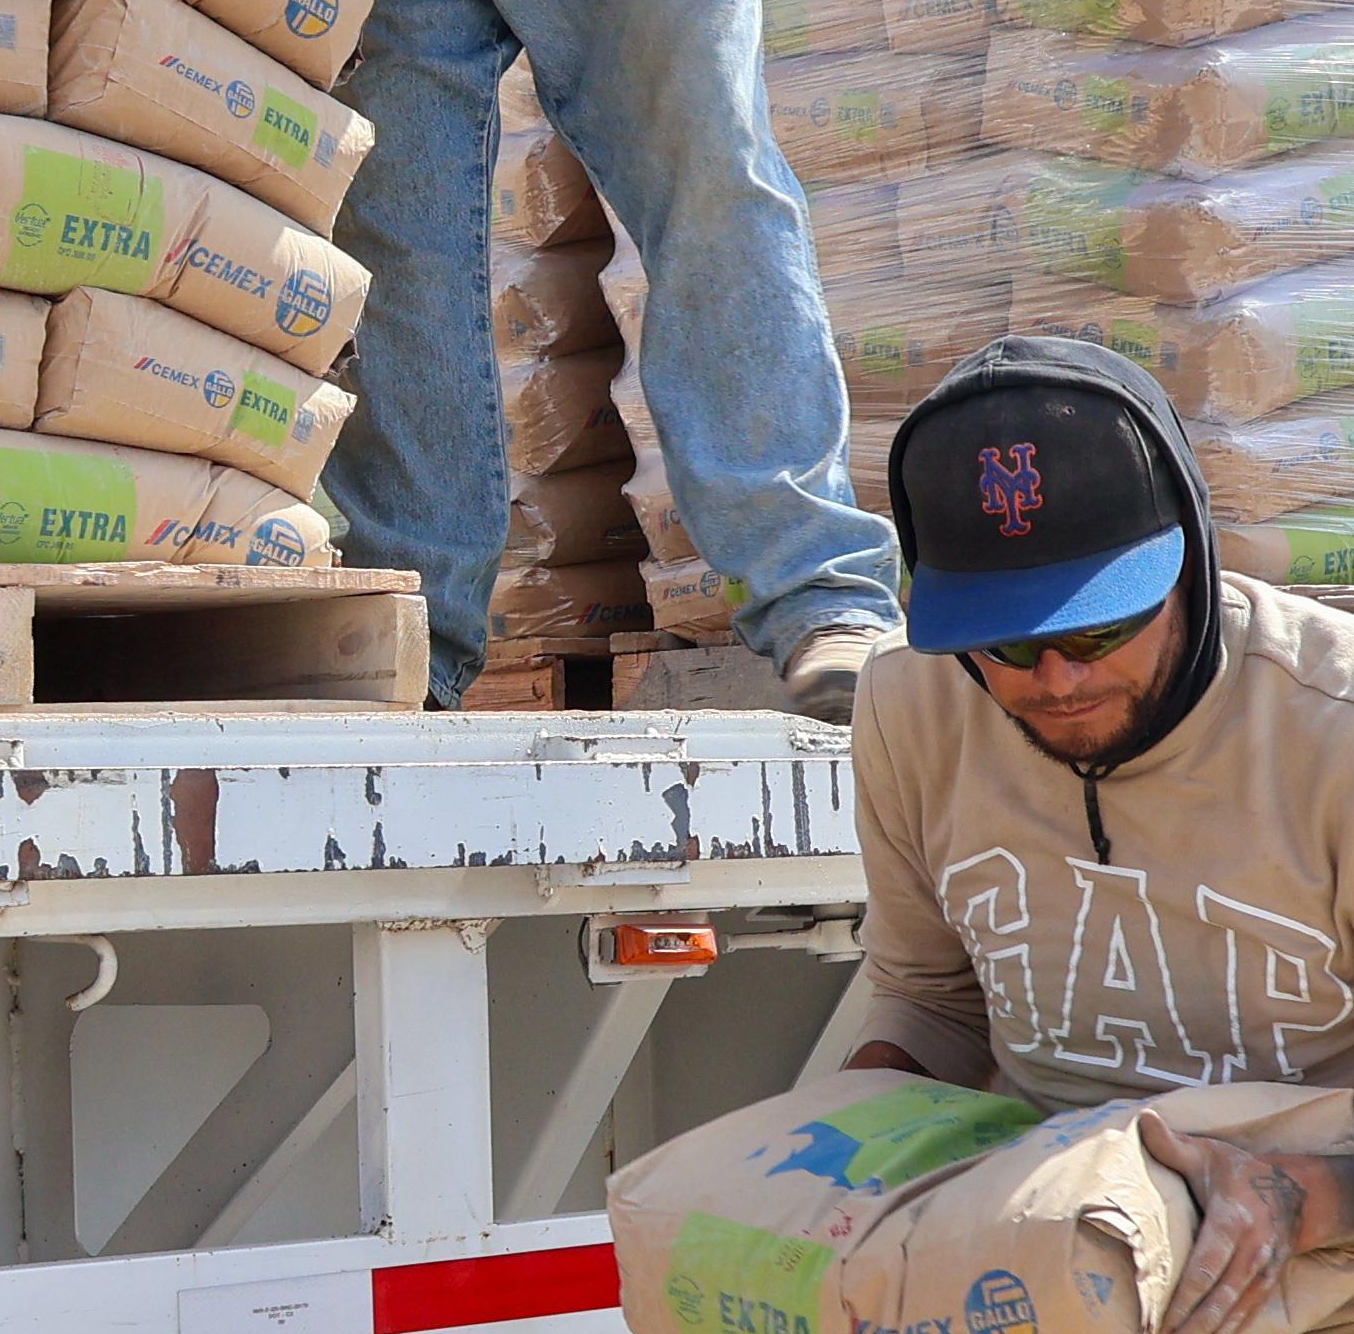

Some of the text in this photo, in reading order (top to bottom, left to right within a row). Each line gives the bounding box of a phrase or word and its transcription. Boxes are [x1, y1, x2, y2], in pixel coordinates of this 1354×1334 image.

[175, 62, 311, 148] CEMEX EXTRA
[60, 213, 151, 262] EXTRA
[187, 245, 276, 301] CEMEX
[281, 290, 328, 321] GALLO
[151, 362, 201, 390] CEMEX
[239, 388, 288, 426] EXTRA
[977, 442, 1043, 538] NY
[39, 507, 127, 544] EXTRA
[172, 519, 245, 550] CMEX
[250, 537, 303, 566] GALLO
[935, 845, 1354, 1088] GAP
[971, 1303, 1031, 1331] GALLO
